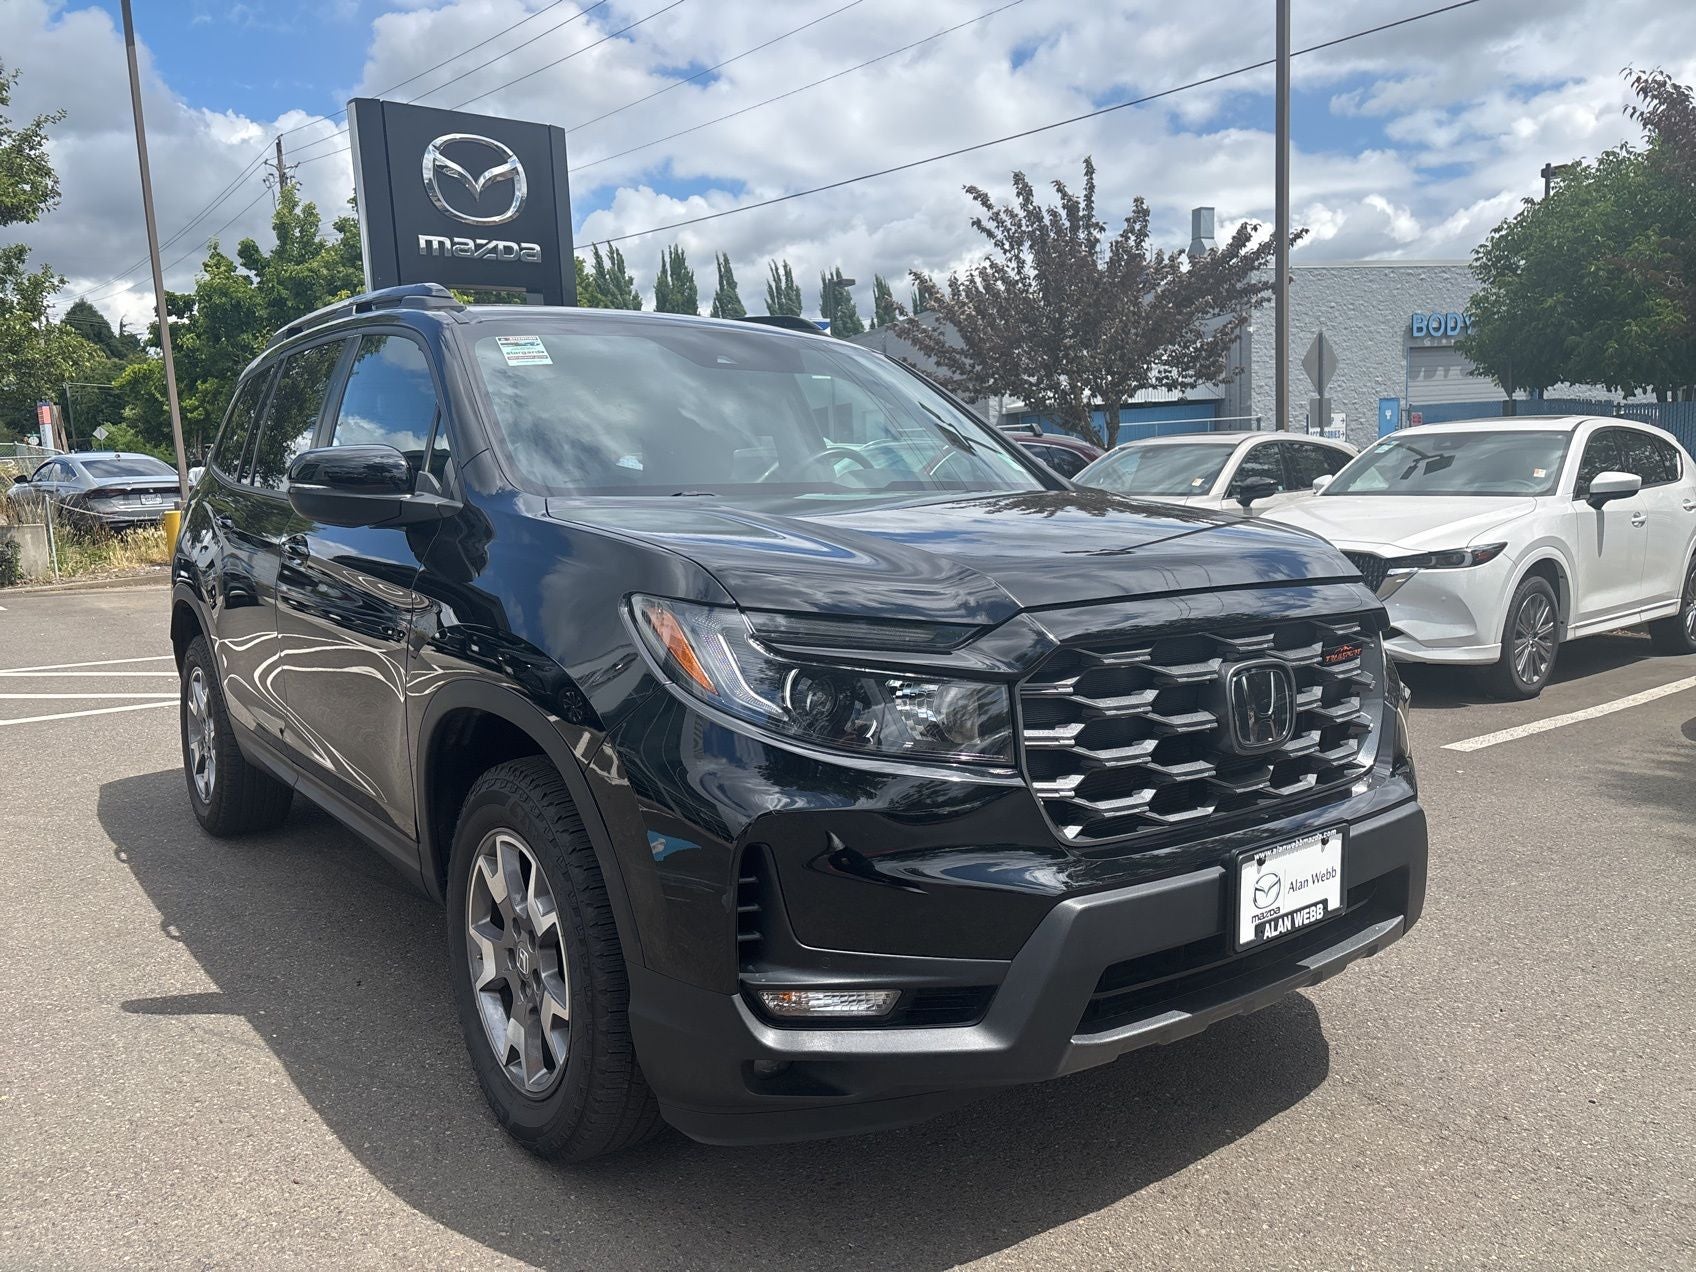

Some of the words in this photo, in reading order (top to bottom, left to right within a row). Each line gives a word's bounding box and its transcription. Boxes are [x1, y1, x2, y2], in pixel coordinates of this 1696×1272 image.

[418, 234, 542, 263] mazda
[1411, 312, 1472, 337] BODY
[1310, 430, 1341, 439] ACCSORIES
[1287, 878, 1309, 894] Alan
[1311, 866, 1337, 885] Webb
[1251, 906, 1281, 924] mazda
[1263, 915, 1292, 940] ALAN
[1293, 903, 1324, 928] WEBB
